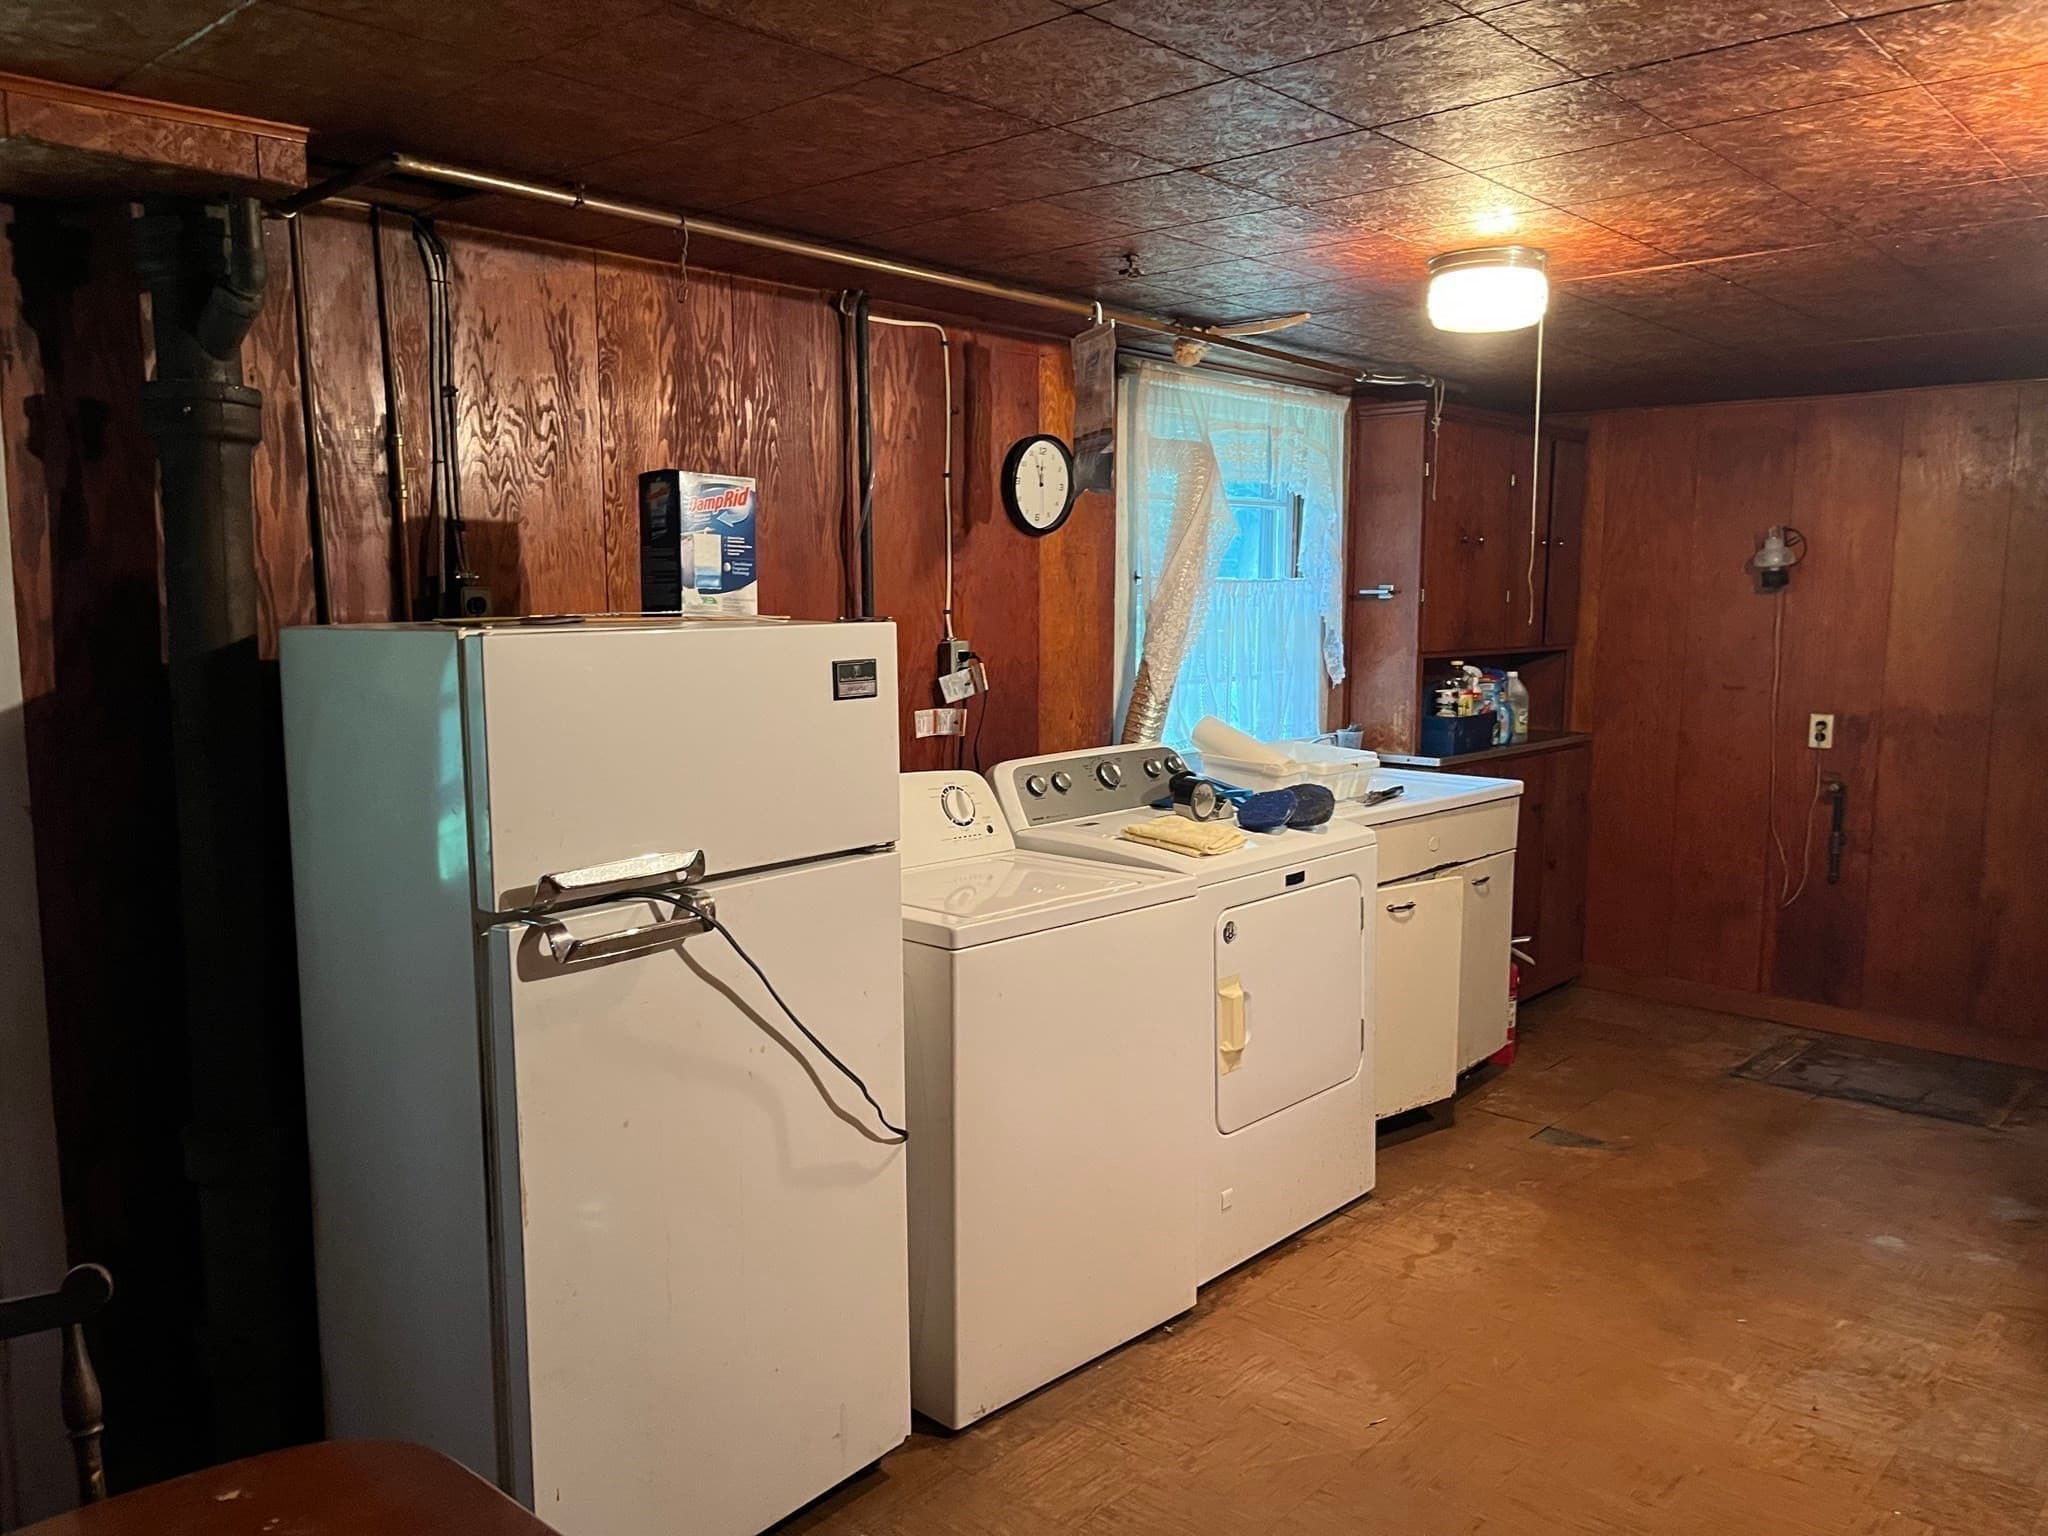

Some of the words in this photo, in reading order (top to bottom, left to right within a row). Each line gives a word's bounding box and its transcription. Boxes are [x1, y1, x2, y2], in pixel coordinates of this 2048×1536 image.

[1039, 447, 1048, 455] 12
[1059, 483, 1064, 491] 3
[1035, 513, 1040, 521] 6
